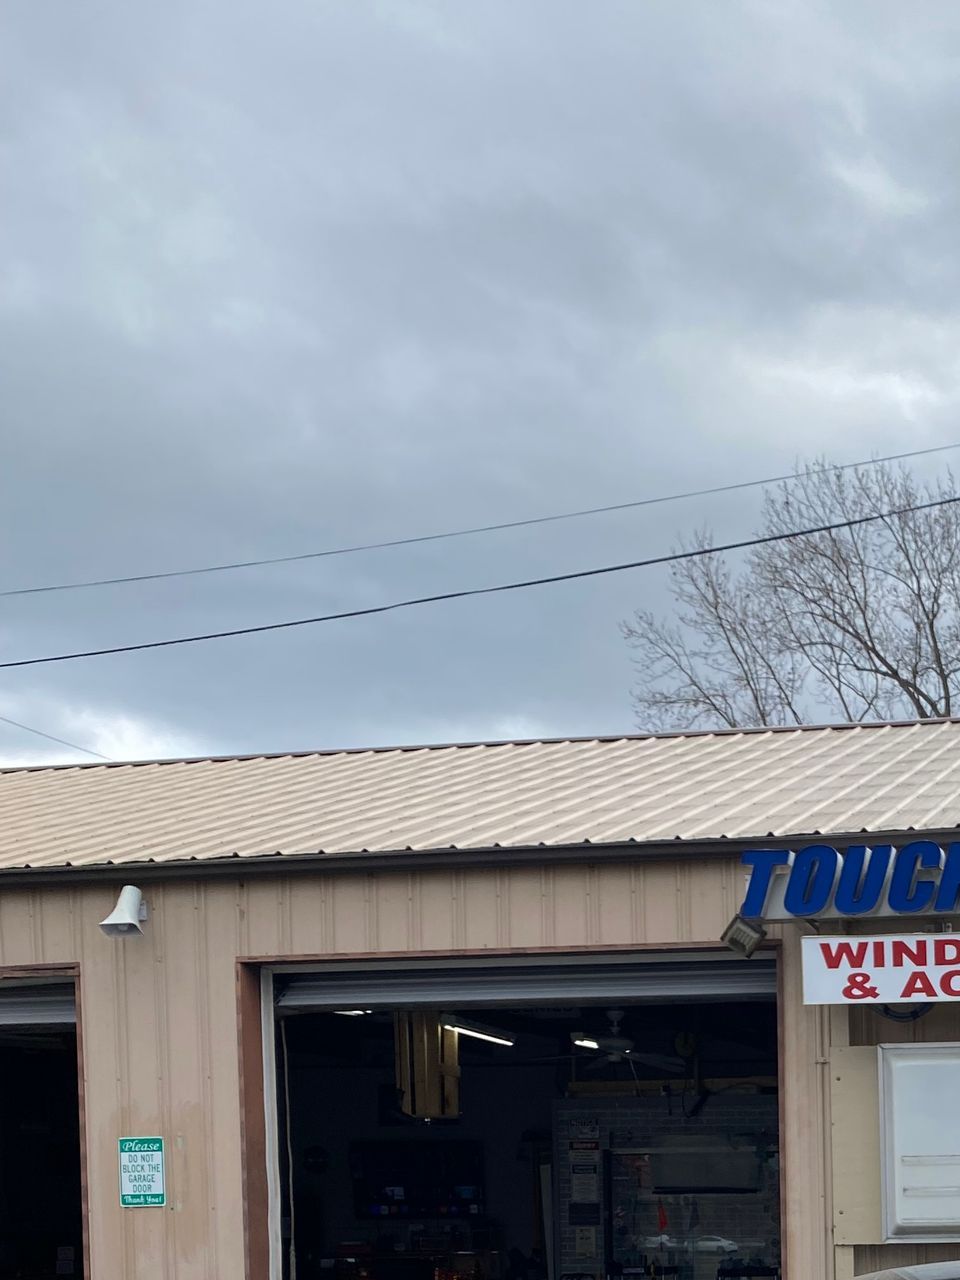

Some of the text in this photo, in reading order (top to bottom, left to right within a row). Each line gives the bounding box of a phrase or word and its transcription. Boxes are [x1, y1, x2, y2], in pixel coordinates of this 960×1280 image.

[842, 972, 880, 1000] &
[122, 1140, 160, 1151] Please
[128, 1154, 154, 1163] DO NOT
[122, 1163, 161, 1173] BLOCK THE
[128, 1174, 156, 1183] GARAGE
[132, 1184, 152, 1193] DOOR
[123, 1195, 145, 1204] Thank
